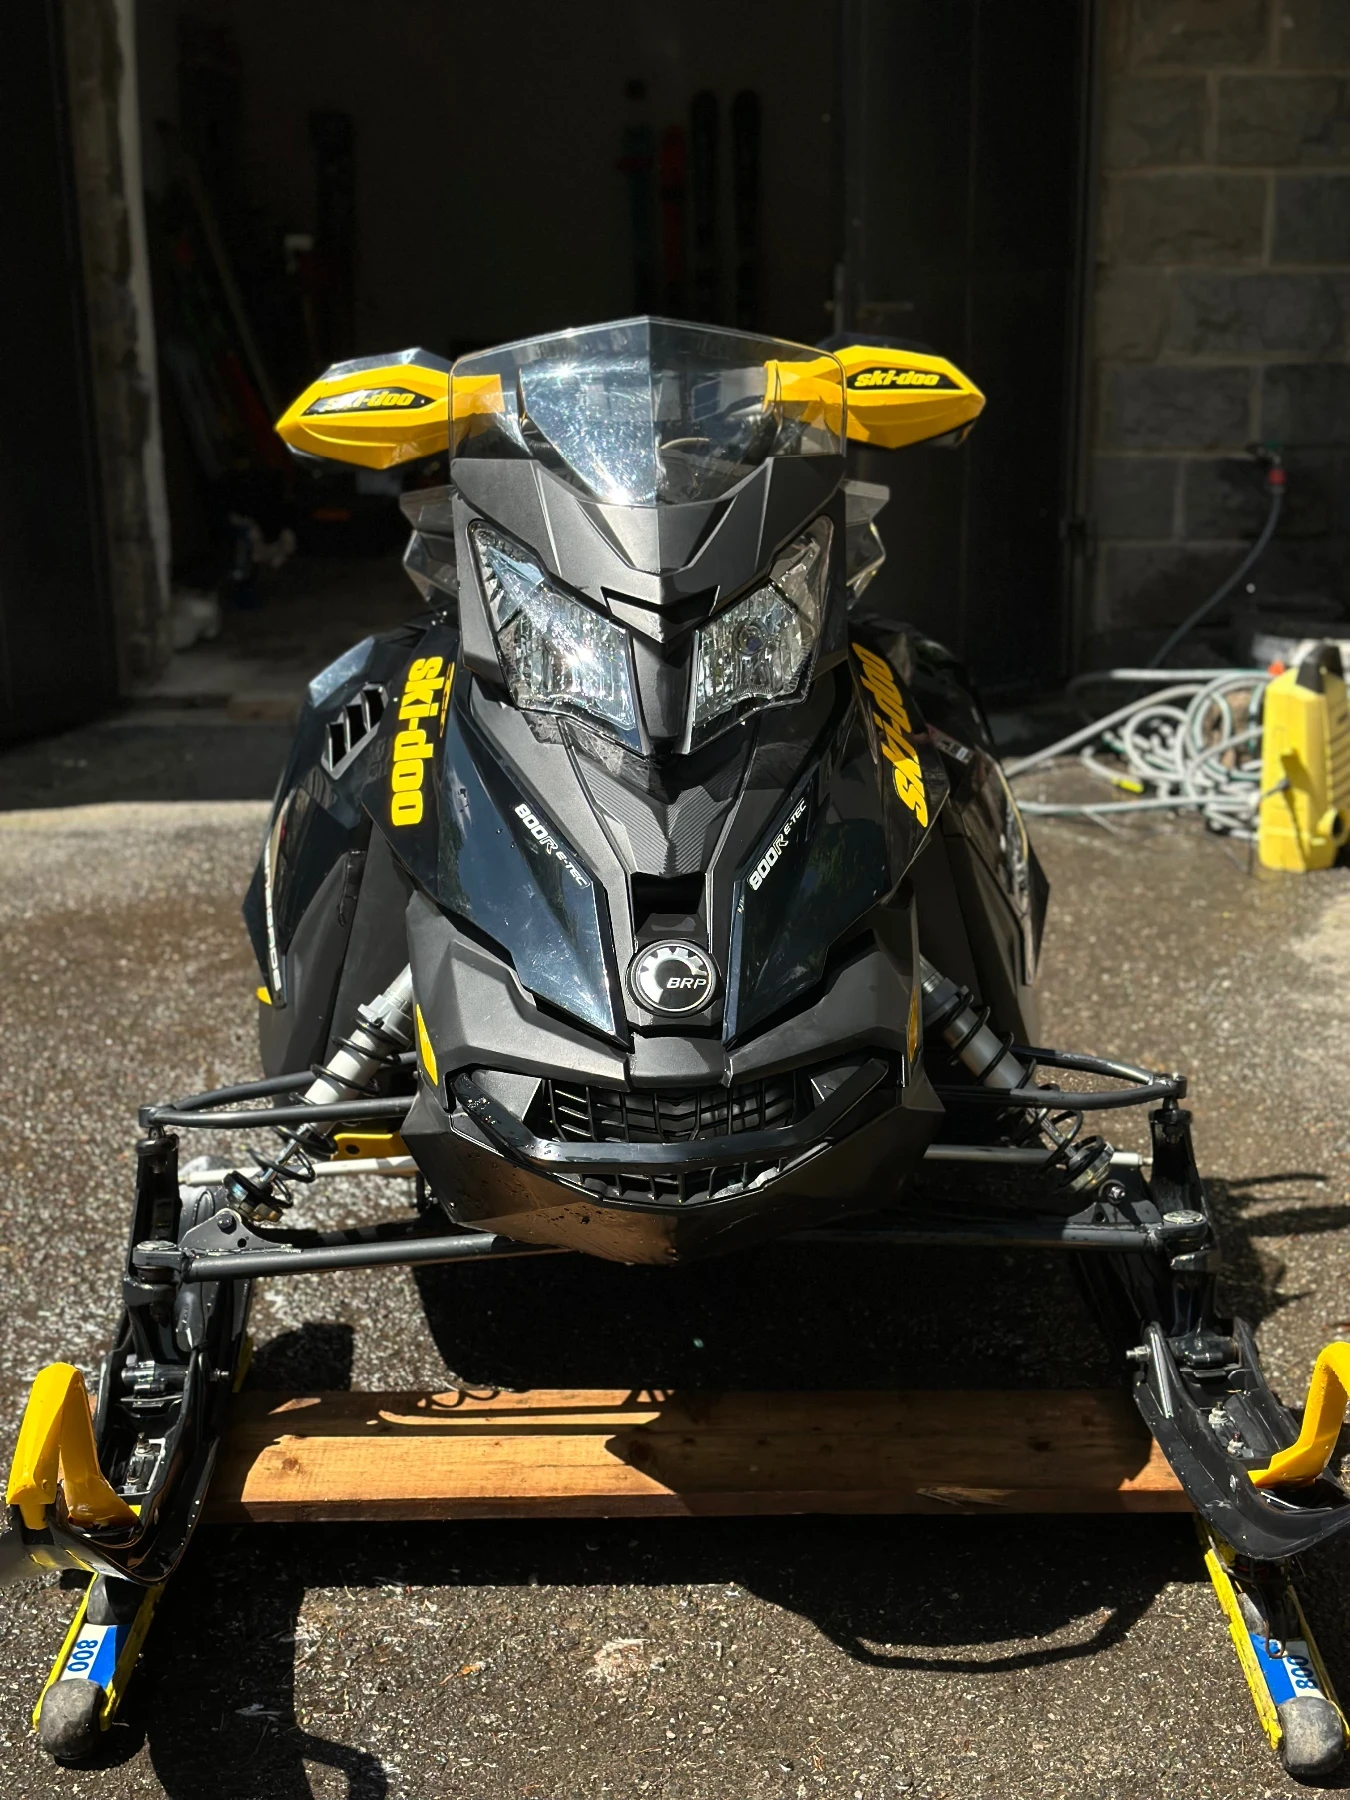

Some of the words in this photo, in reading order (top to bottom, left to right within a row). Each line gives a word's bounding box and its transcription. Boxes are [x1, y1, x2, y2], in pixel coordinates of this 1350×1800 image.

[854, 370, 940, 387] ski-doo
[391, 656, 445, 827] ski-doo
[852, 642, 929, 828] ski-doo
[514, 803, 559, 855] 800R
[748, 833, 789, 891] 800R
[666, 977, 707, 990] BRP
[67, 1639, 99, 1672] 800
[1286, 1655, 1319, 1690] 800
